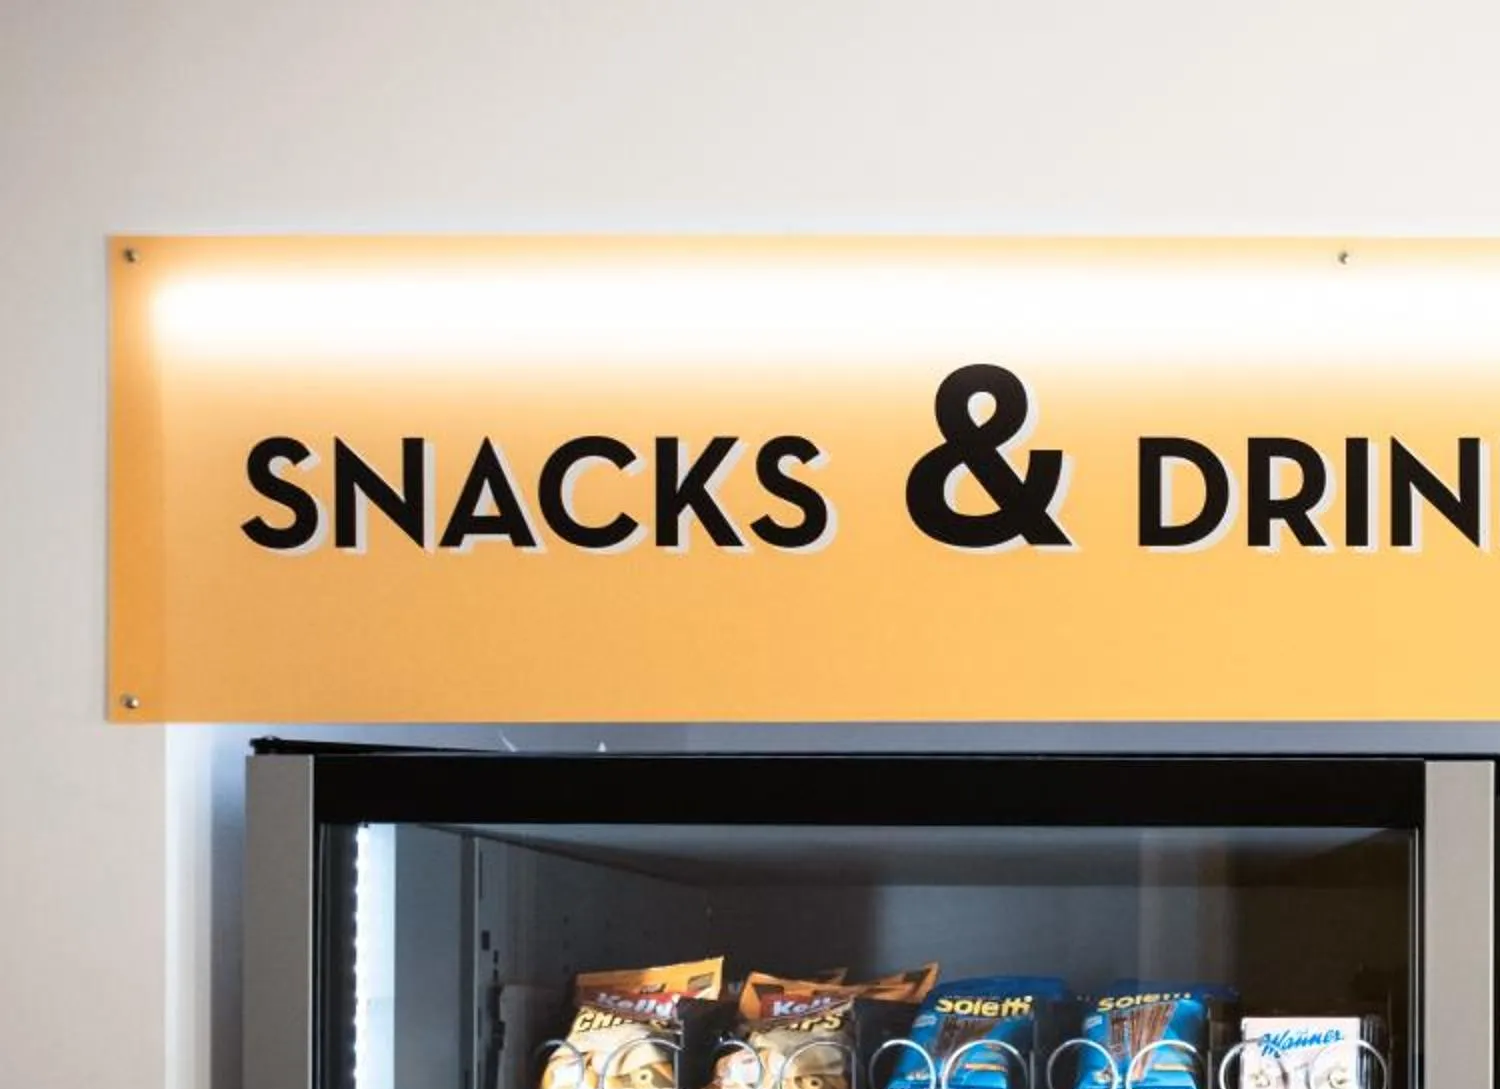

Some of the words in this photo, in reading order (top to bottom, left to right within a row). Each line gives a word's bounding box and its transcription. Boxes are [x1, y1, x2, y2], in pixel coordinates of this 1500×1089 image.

[241, 434, 836, 554] SNACKS
[905, 362, 1078, 551] &
[1260, 1026, 1342, 1057] Manner
